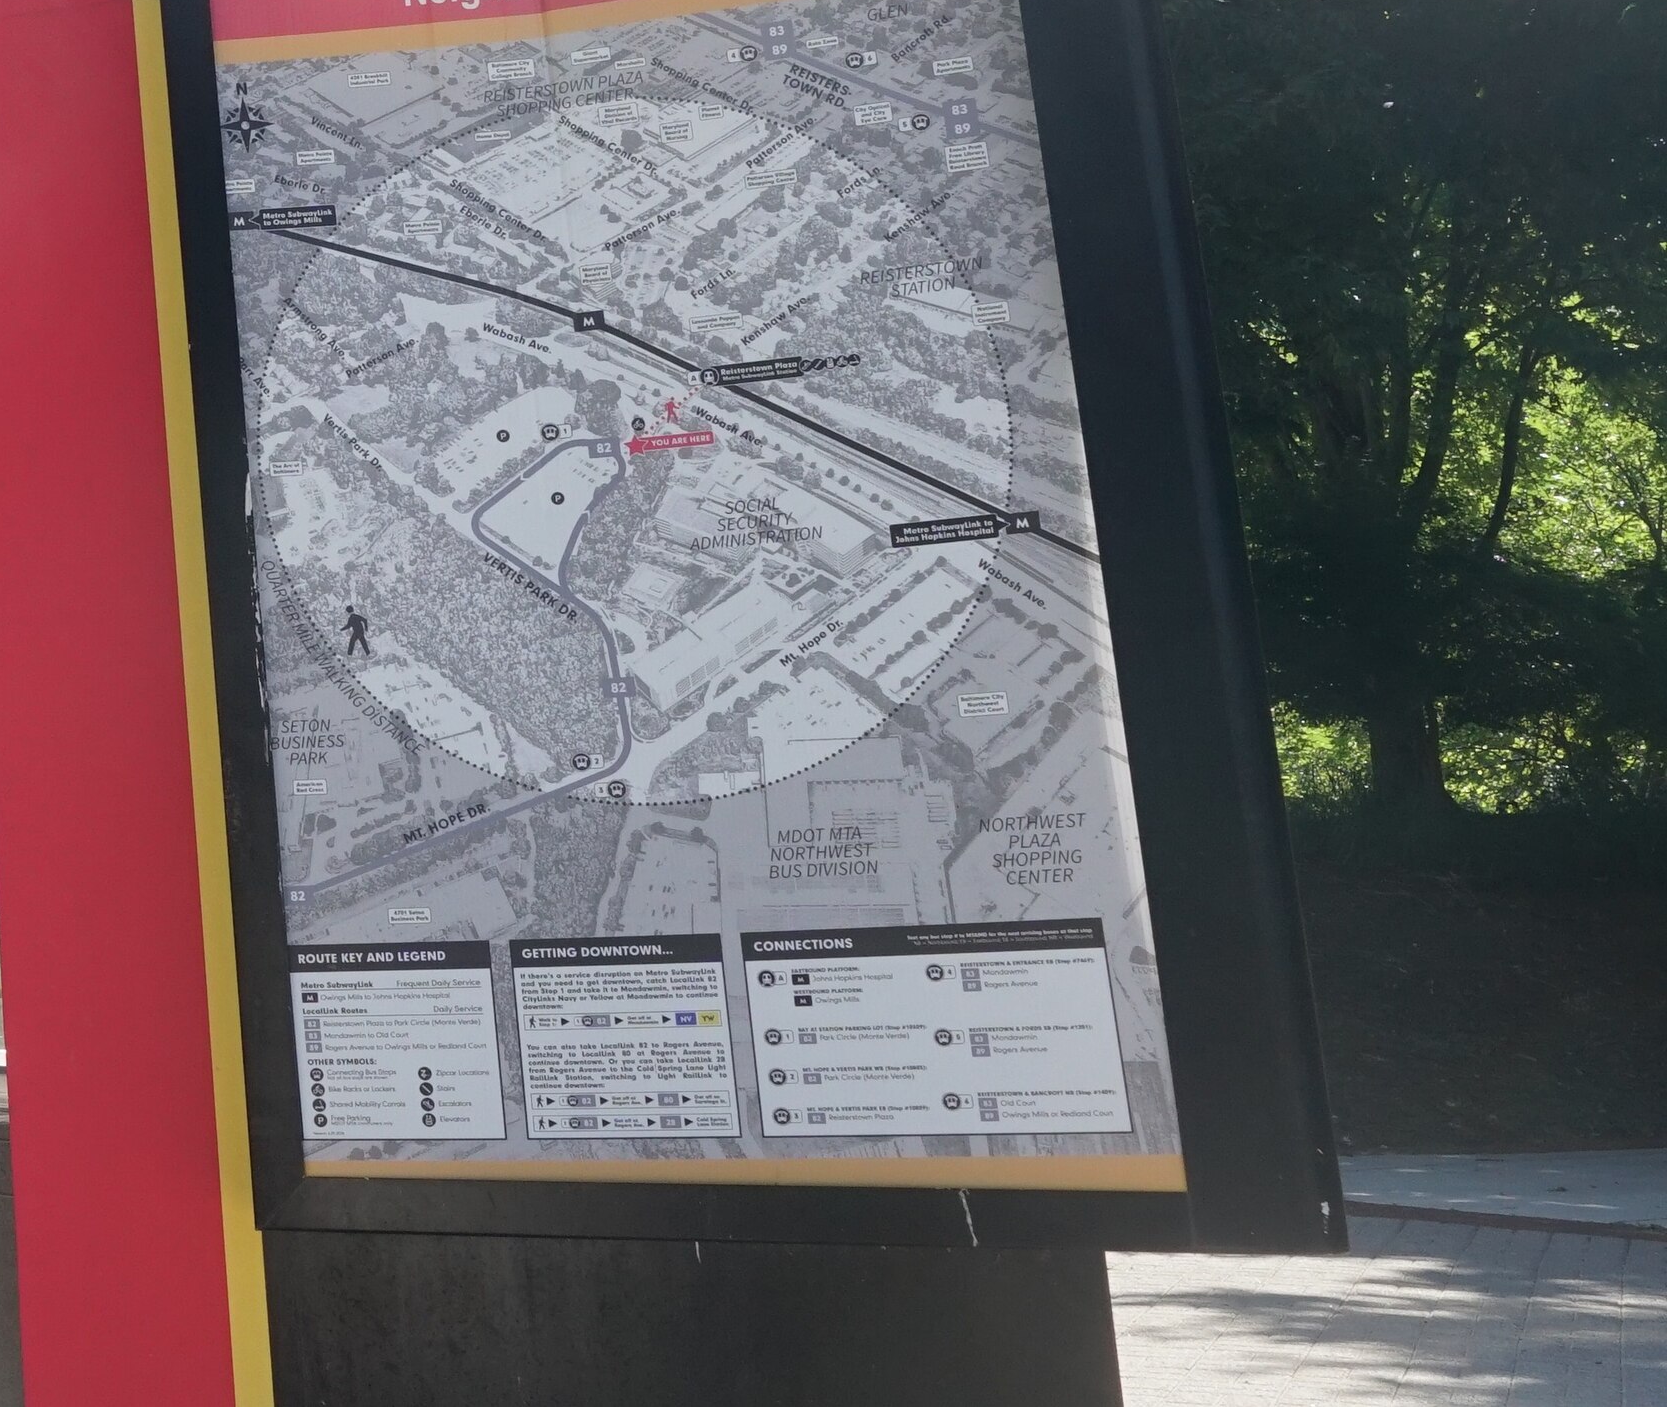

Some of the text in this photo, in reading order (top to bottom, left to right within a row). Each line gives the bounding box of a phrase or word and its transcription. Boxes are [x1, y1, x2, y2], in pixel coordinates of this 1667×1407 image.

[867, 4, 908, 21] GLEN
[769, 25, 785, 37] 83
[891, 16, 953, 62] Bancroft Rd.
[771, 44, 788, 56] 89
[235, 82, 248, 96] N
[484, 71, 643, 103] REISTERSTOWN PLAZA
[651, 58, 755, 113] Shopping Center Dr.
[783, 75, 822, 98] TOWN
[498, 88, 634, 117] SHOPPING CENTER
[951, 104, 968, 116] 83
[311, 116, 349, 143] Vincent
[954, 122, 972, 135] 89
[559, 116, 658, 175] Shopping Center Dr.
[746, 133, 794, 169] Patterson
[275, 175, 309, 191] Eberle
[838, 175, 869, 199] Fords
[262, 208, 333, 220] Metro SubwayLink
[450, 180, 546, 242] Shopping Center Dr.
[460, 205, 491, 229] Eberle
[233, 216, 246, 227] M
[262, 215, 323, 227] to Owings Mills
[605, 209, 681, 250] Patterson Ave.
[884, 206, 930, 243] Kenshaw
[860, 257, 982, 284] REISTERSTOWN
[691, 276, 721, 299] Fords
[891, 276, 955, 297] STATION
[284, 297, 327, 341] Armstrong
[583, 315, 596, 327] M
[741, 311, 786, 346] Kenshaw
[483, 323, 552, 354] Wabash Ave.
[345, 350, 394, 378] Patterson
[720, 361, 798, 376] Reisterstown Plaza
[696, 407, 739, 433] Wabash
[324, 413, 349, 439] Vertis
[349, 438, 370, 459] Park
[650, 433, 711, 448] YOU ARE HERE
[596, 442, 612, 454] 82
[725, 498, 779, 514] SOCIAL
[717, 513, 793, 532] SECURITY
[902, 518, 994, 536] Metro SubwayLink to
[1015, 518, 1030, 530] M
[690, 526, 822, 550] ADMINISTRATION
[894, 526, 995, 545] Johns Hopkins Hospital
[483, 552, 523, 584] VERTIS
[525, 582, 558, 608] PARK
[978, 558, 1047, 610] Wabash Ave.
[801, 630, 827, 656] Hope
[262, 561, 425, 754] QUARTER MILE WALKING DISTANCE
[610, 682, 627, 693] 82
[281, 719, 331, 733] SETON
[270, 735, 345, 750] BUSINESS
[290, 752, 328, 765] PARK
[403, 804, 490, 844] MT. HOPE DR.
[979, 813, 1086, 833] NORTHWEST
[778, 826, 862, 844] MDOT MTA
[1009, 833, 1061, 849] PLAZA
[771, 844, 873, 861] NORTHWEST
[993, 850, 1082, 869] SHOPPING
[770, 861, 877, 879] BUS DIVISION
[1006, 868, 1074, 885] CENTER
[290, 890, 307, 902] 82
[521, 944, 674, 960] GETTING DOWNTOWN...
[754, 938, 853, 952] CONNECTIONS
[297, 950, 446, 965] ROUTE KEY AND LEGEND
[300, 981, 325, 990] Metro
[452, 978, 481, 987] Service
[454, 1004, 484, 1013] Service
[307, 1058, 335, 1067] OTHER
